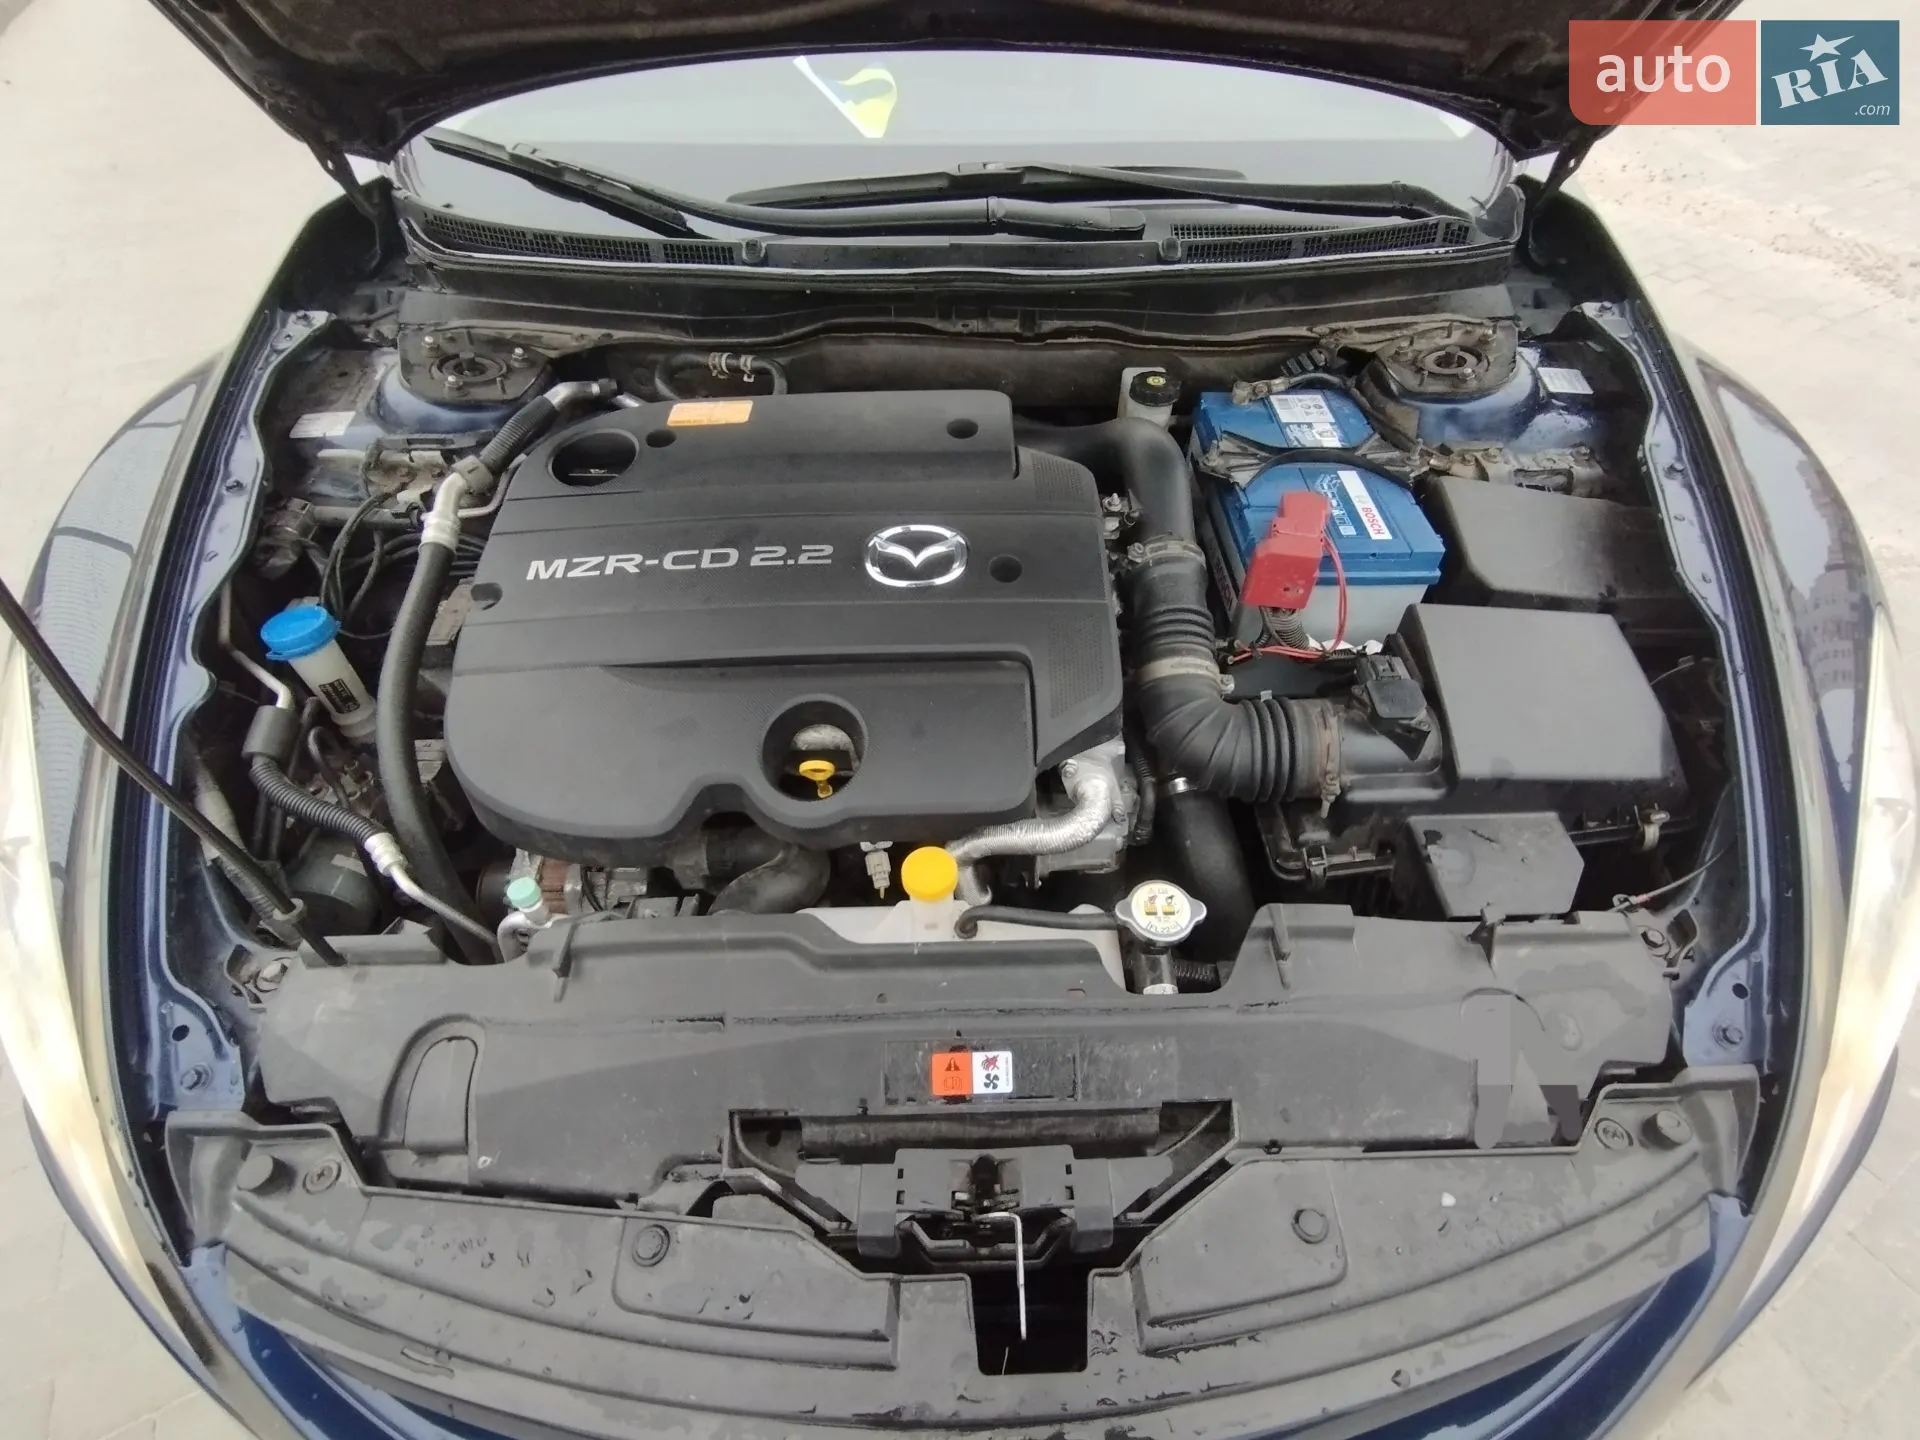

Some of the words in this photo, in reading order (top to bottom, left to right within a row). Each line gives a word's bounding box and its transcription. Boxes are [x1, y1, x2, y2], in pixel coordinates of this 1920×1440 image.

[1361, 506, 1386, 535] BOSCH
[526, 547, 740, 581] MZR-CD
[750, 544, 834, 567] 2.2
